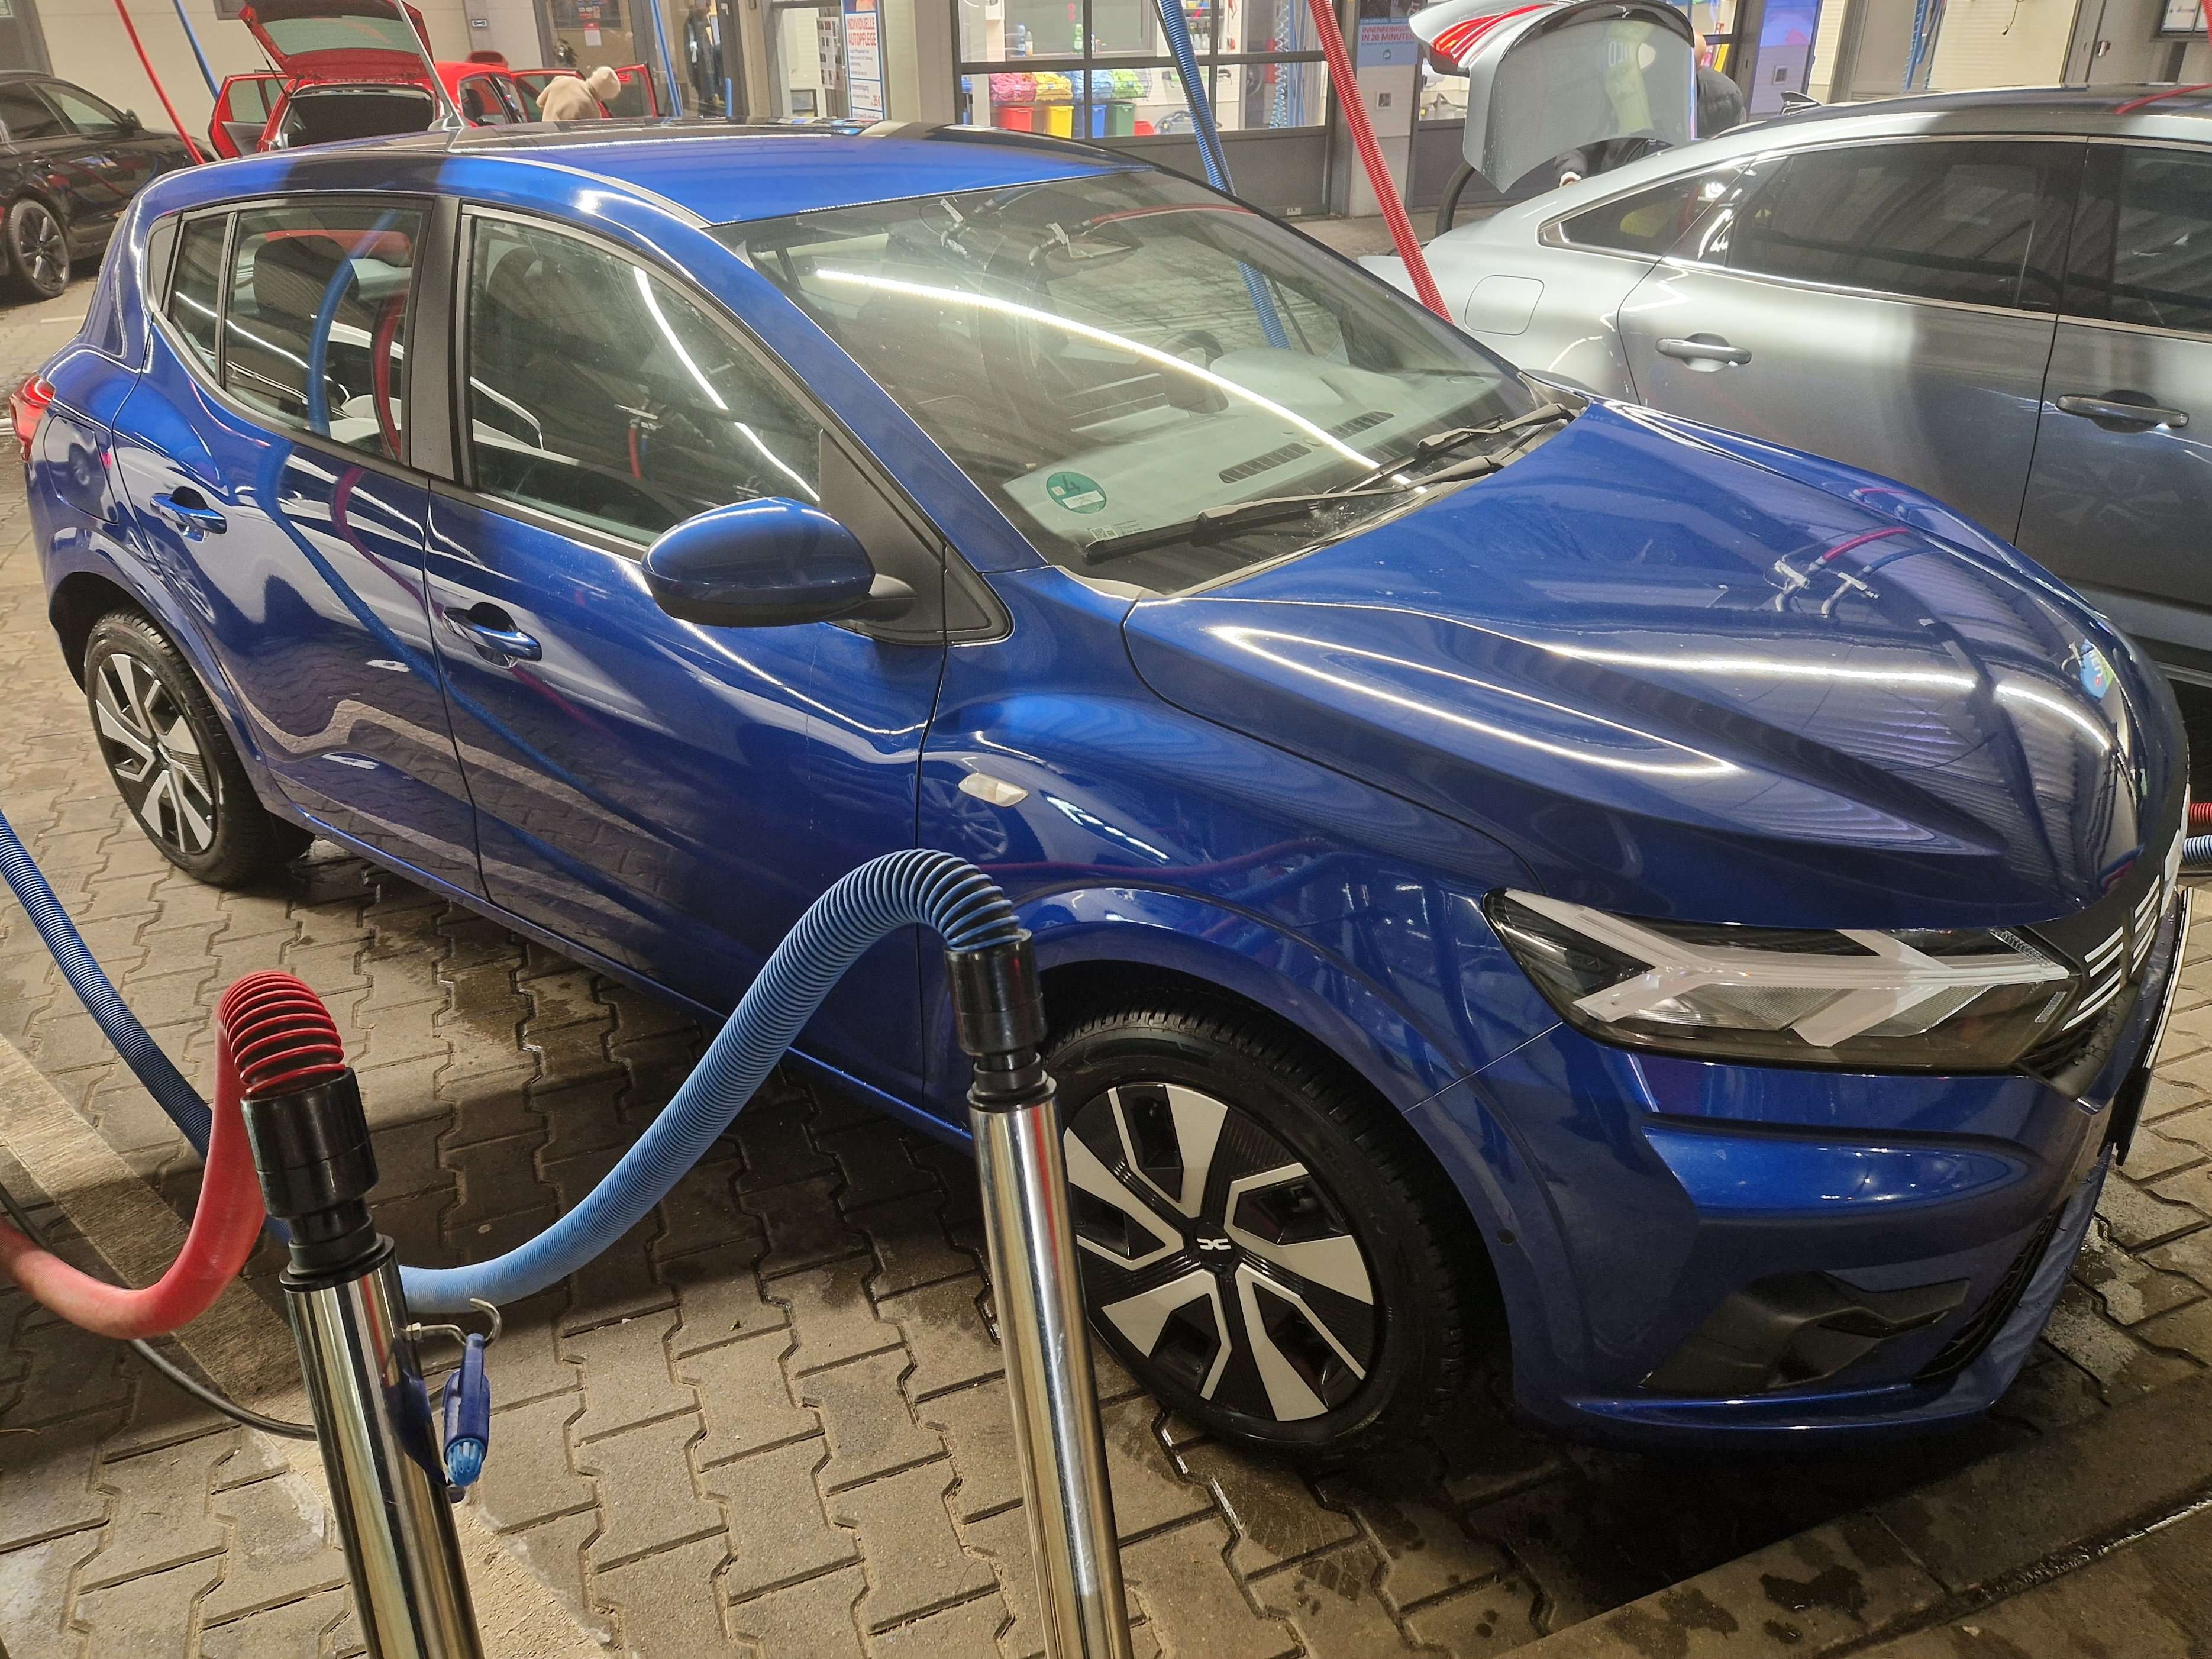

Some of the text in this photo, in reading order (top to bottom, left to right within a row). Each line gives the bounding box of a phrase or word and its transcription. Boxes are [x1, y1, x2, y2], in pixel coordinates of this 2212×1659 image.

[848, 32, 876, 46] AUTOPFLEGE
[1371, 33, 1379, 41] 20
[1061, 474, 1081, 492] 4
